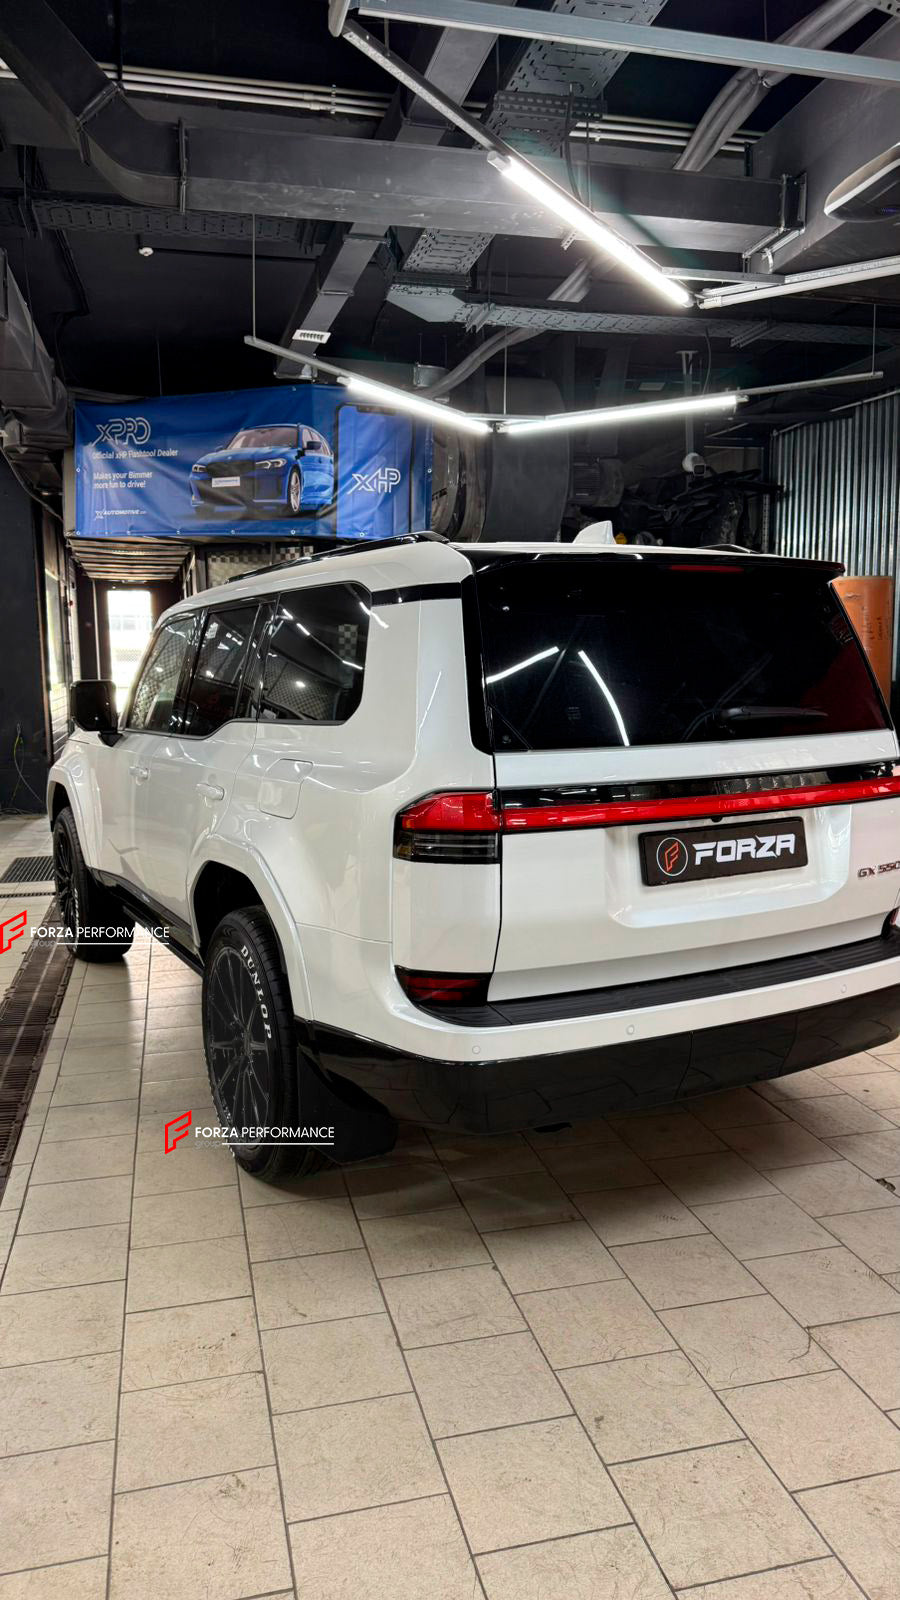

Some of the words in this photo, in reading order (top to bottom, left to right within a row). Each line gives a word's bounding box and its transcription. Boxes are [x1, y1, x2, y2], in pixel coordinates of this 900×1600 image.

[158, 448, 178, 457] Dealer
[93, 472, 112, 480] Makes
[112, 472, 128, 481] your
[128, 471, 153, 479] Bimmer
[108, 481, 119, 489] fun
[127, 480, 146, 488] drive!
[692, 833, 796, 866] FORZA
[858, 867, 876, 878] GX
[240, 944, 272, 1039] DUNLOP
